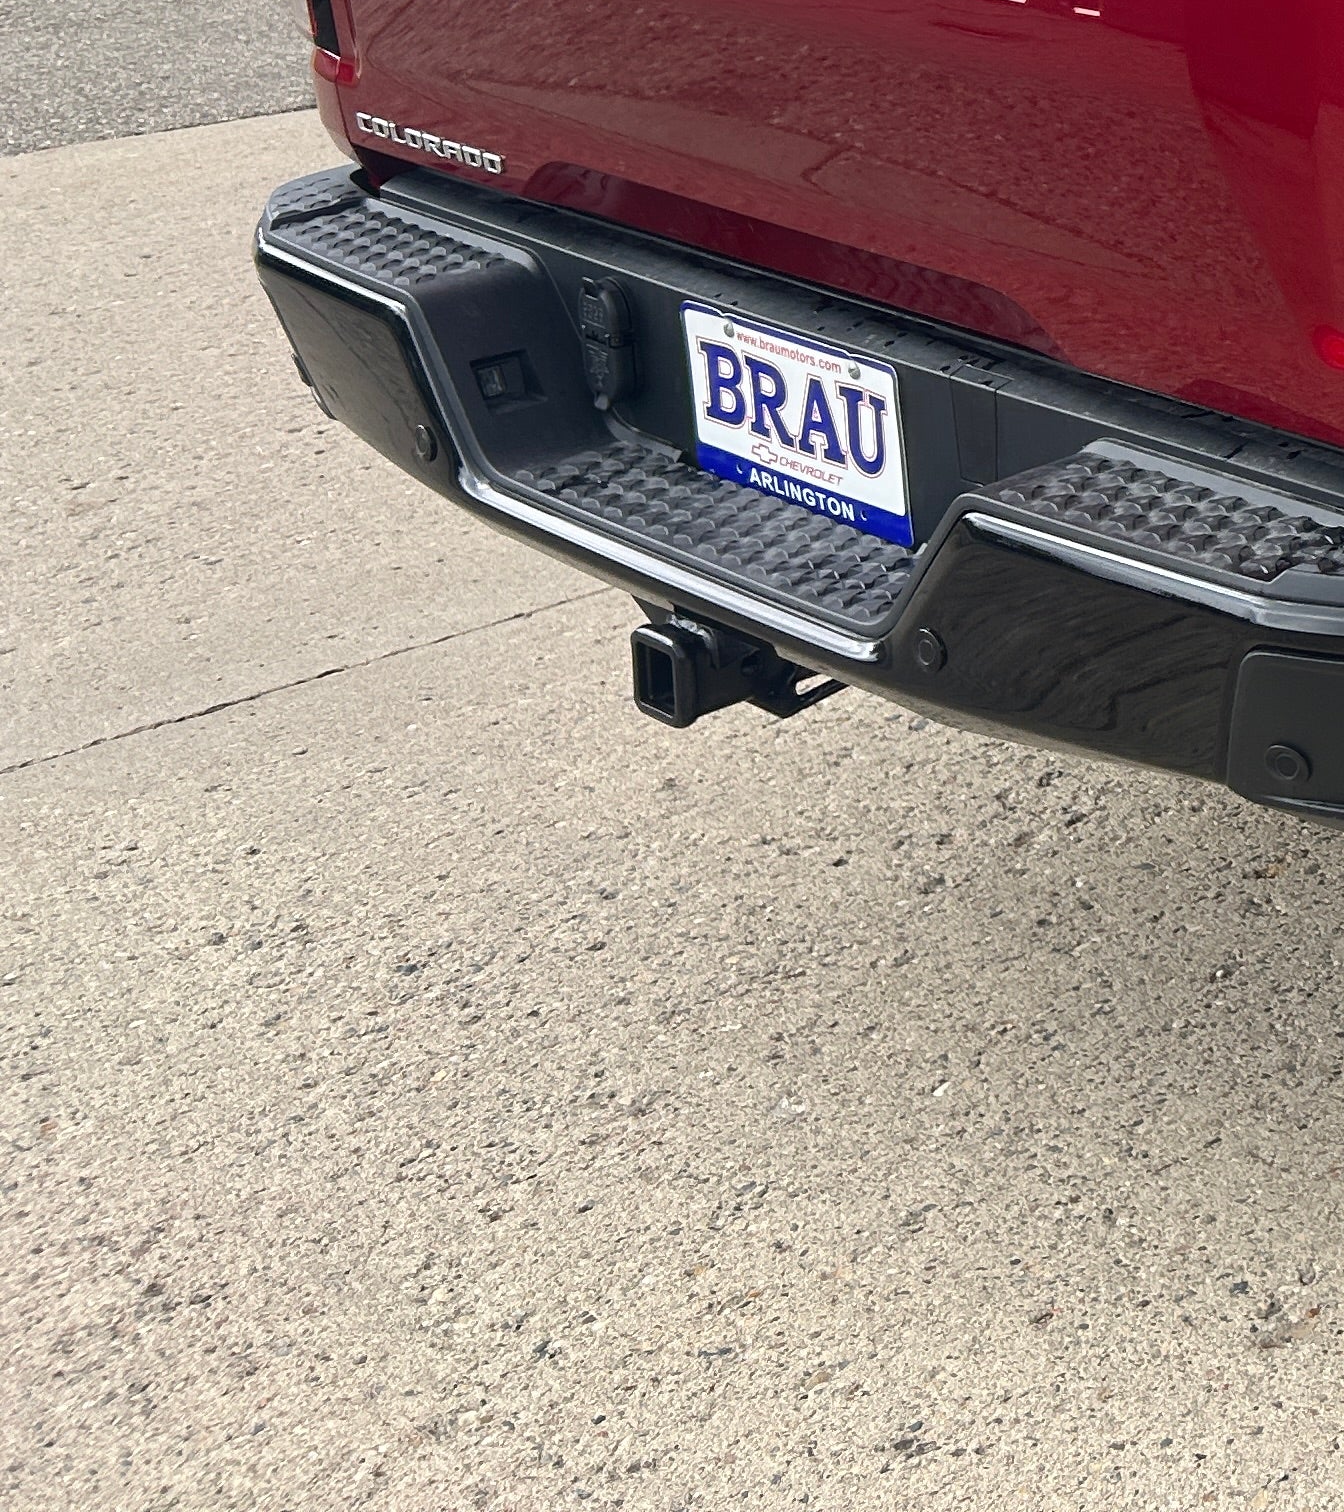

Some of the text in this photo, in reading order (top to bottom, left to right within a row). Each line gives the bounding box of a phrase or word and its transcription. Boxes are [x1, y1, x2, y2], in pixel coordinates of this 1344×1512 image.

[356, 111, 503, 174] COLORADO
[736, 330, 842, 373] www.braumotors.com
[696, 336, 889, 479] BRAU
[750, 467, 856, 521] ARLINGTON
[779, 456, 843, 486] CHEVROLET
